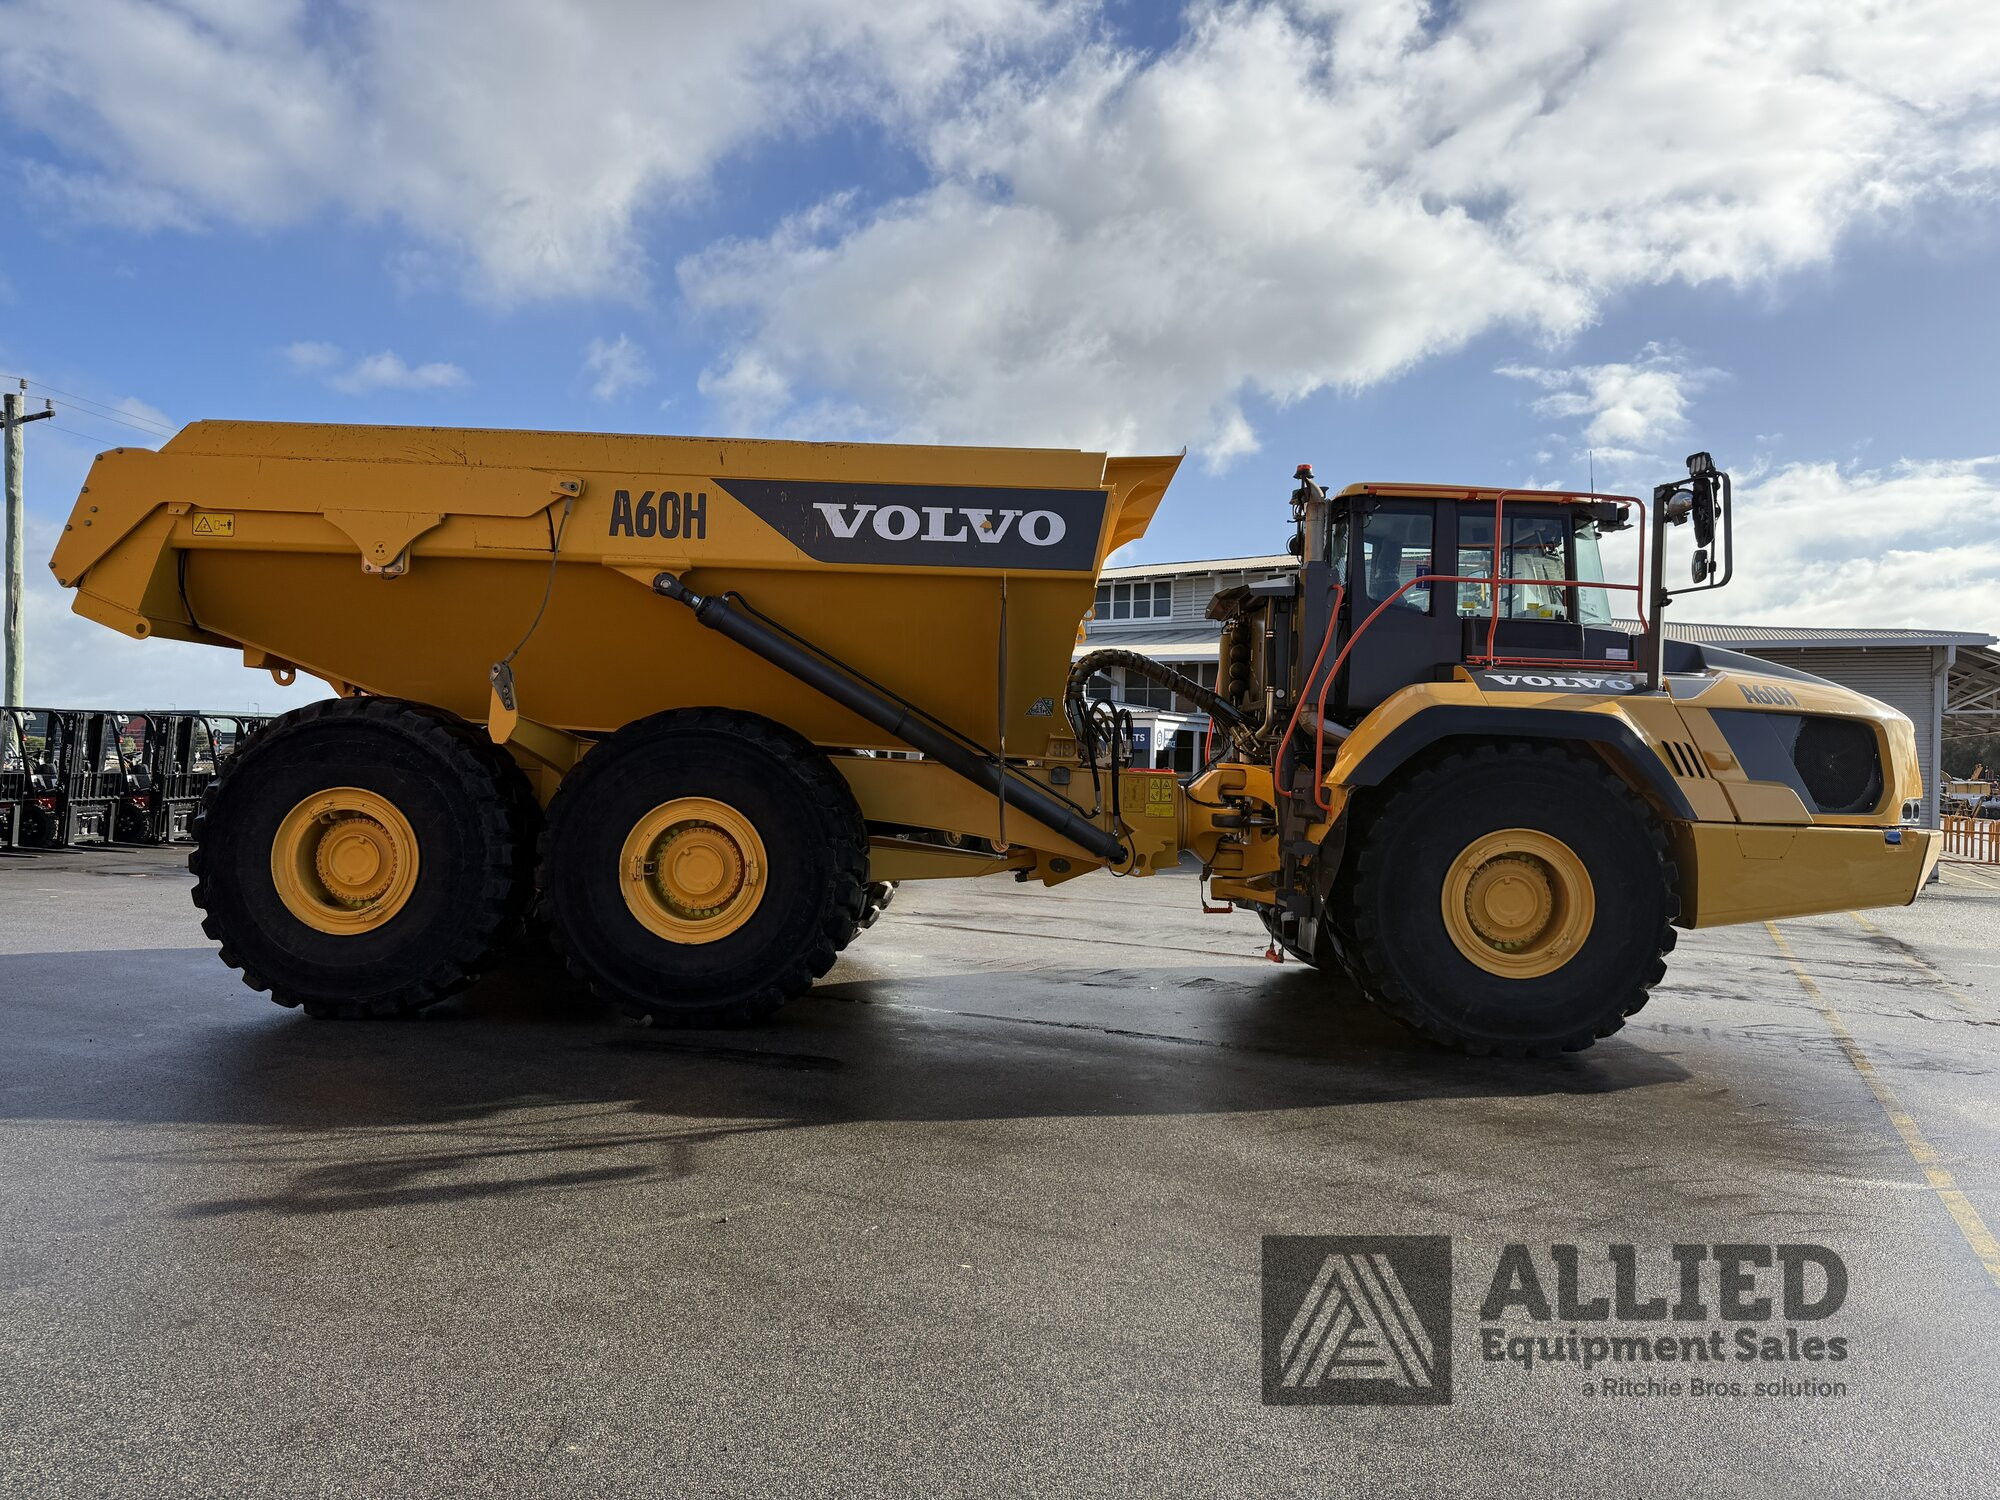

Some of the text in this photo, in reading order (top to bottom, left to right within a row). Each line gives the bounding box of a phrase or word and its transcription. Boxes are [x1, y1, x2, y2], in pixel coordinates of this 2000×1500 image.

[608, 489, 707, 540] A60H
[812, 502, 1067, 546] VOLVO
[1484, 674, 1635, 691] VOLVO
[1737, 683, 1801, 707] A60H
